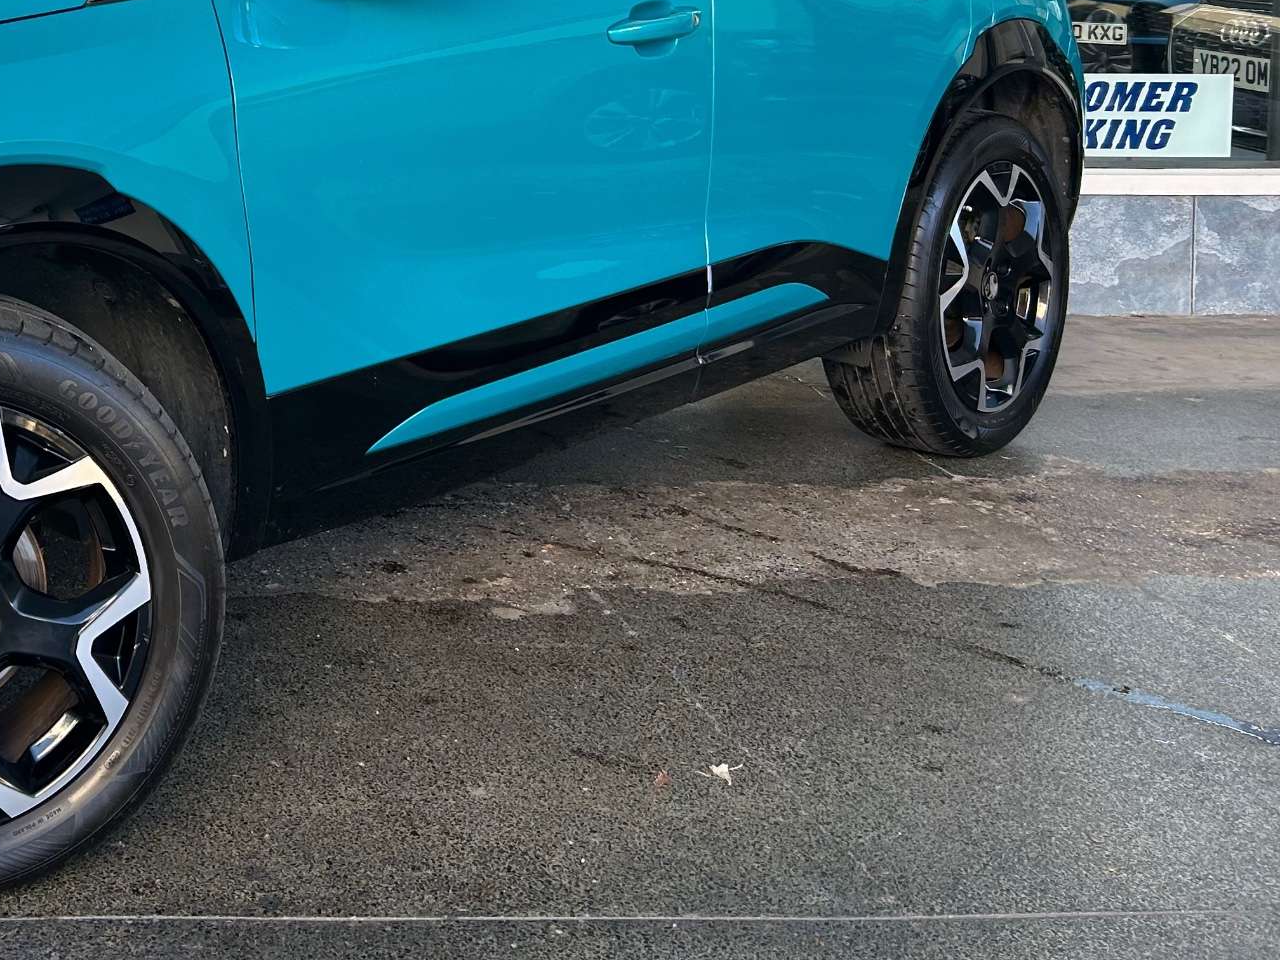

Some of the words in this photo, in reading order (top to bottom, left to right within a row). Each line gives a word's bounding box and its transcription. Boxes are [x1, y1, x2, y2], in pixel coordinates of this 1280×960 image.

[1087, 24, 1124, 41] KXG
[1086, 81, 1198, 112] OMER
[1086, 119, 1176, 150] KING
